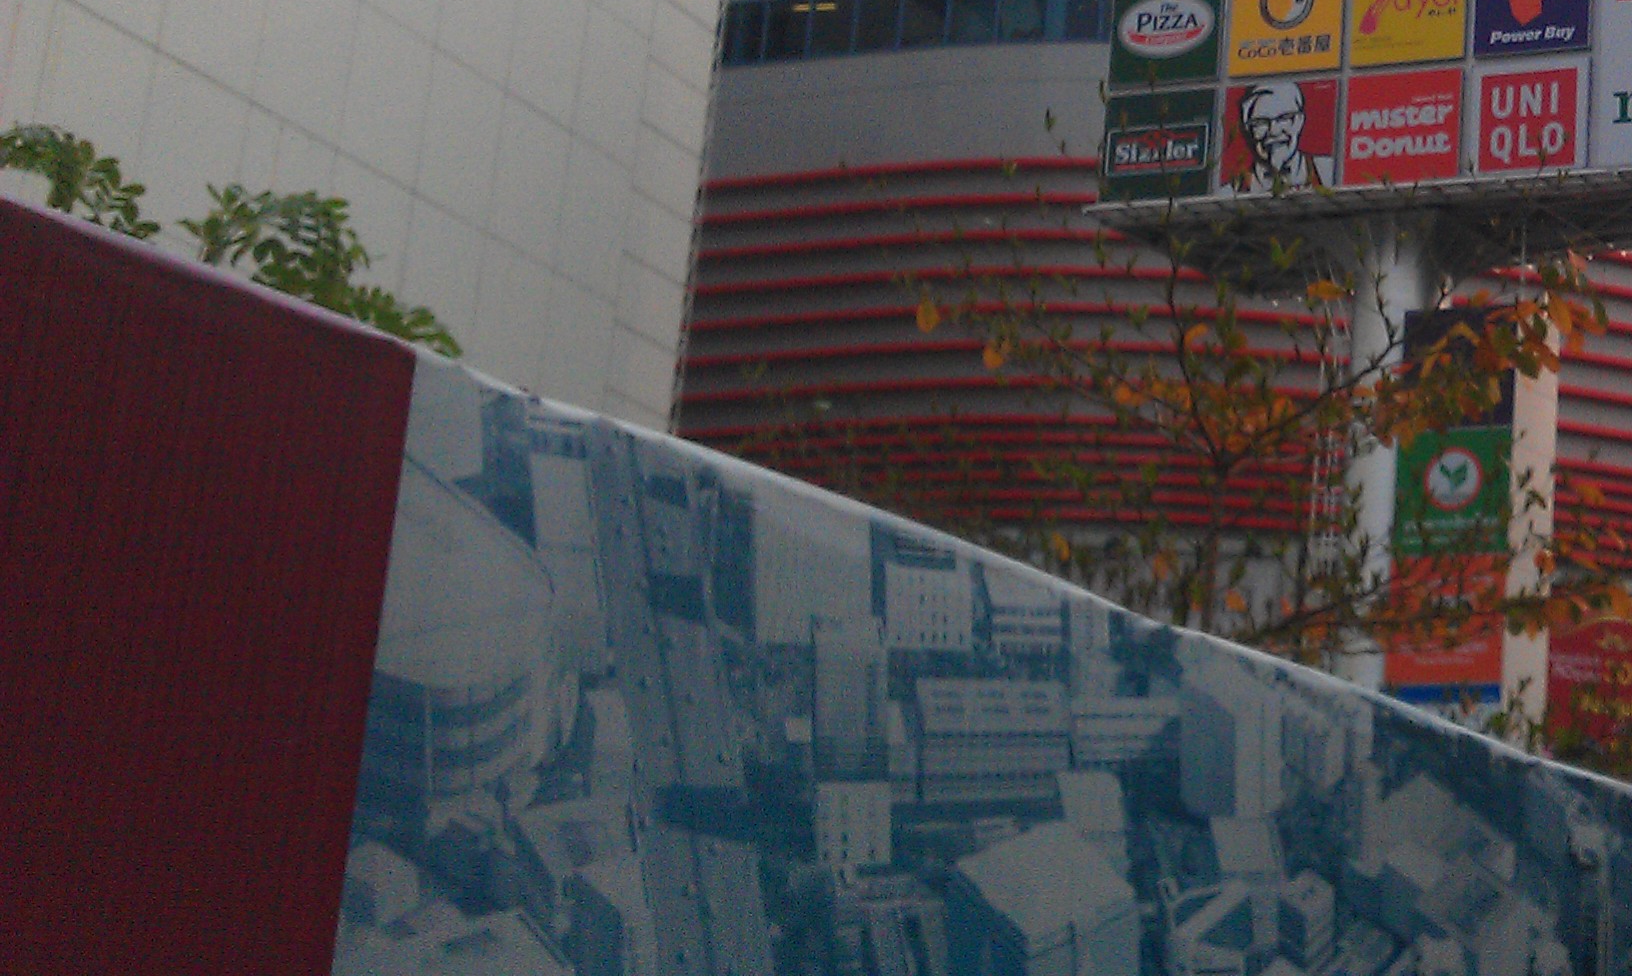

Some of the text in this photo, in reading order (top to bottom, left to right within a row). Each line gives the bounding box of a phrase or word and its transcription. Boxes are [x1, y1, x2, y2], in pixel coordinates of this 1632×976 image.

[1136, 12, 1199, 33] PIZZA
[1490, 25, 1576, 45] Power Buy
[1491, 81, 1560, 119] UNI
[1350, 132, 1452, 160] Donut
[1490, 121, 1566, 165] QLO
